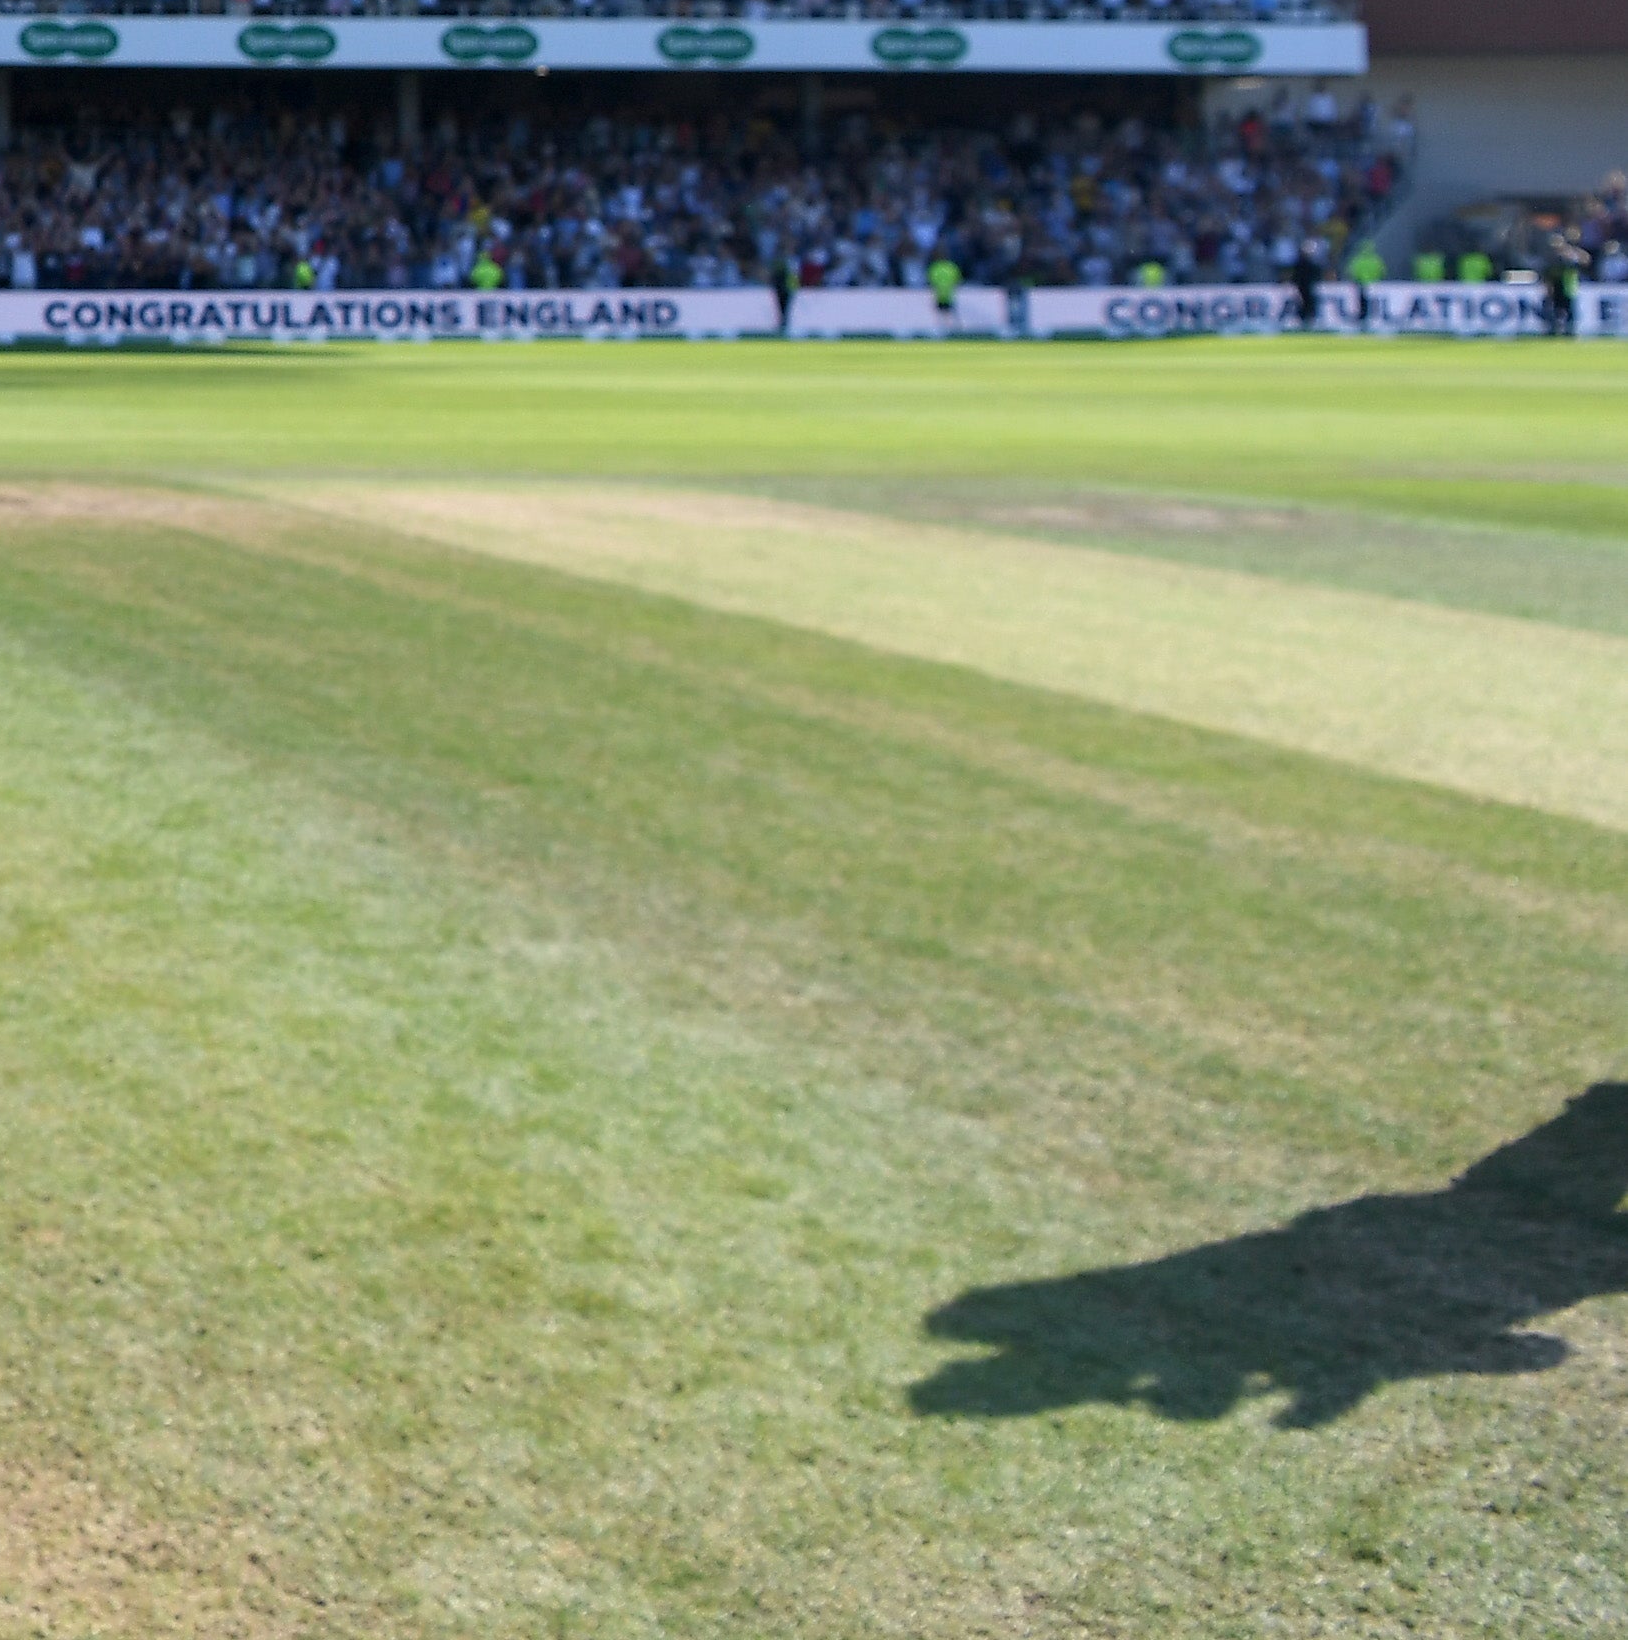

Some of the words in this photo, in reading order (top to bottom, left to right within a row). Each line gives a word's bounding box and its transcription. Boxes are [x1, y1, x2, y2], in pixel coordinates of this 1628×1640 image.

[44, 298, 462, 330] CONGRATULATIONS
[475, 298, 679, 330] ENGLAND
[1106, 293, 1548, 330] CONGRAULATION
